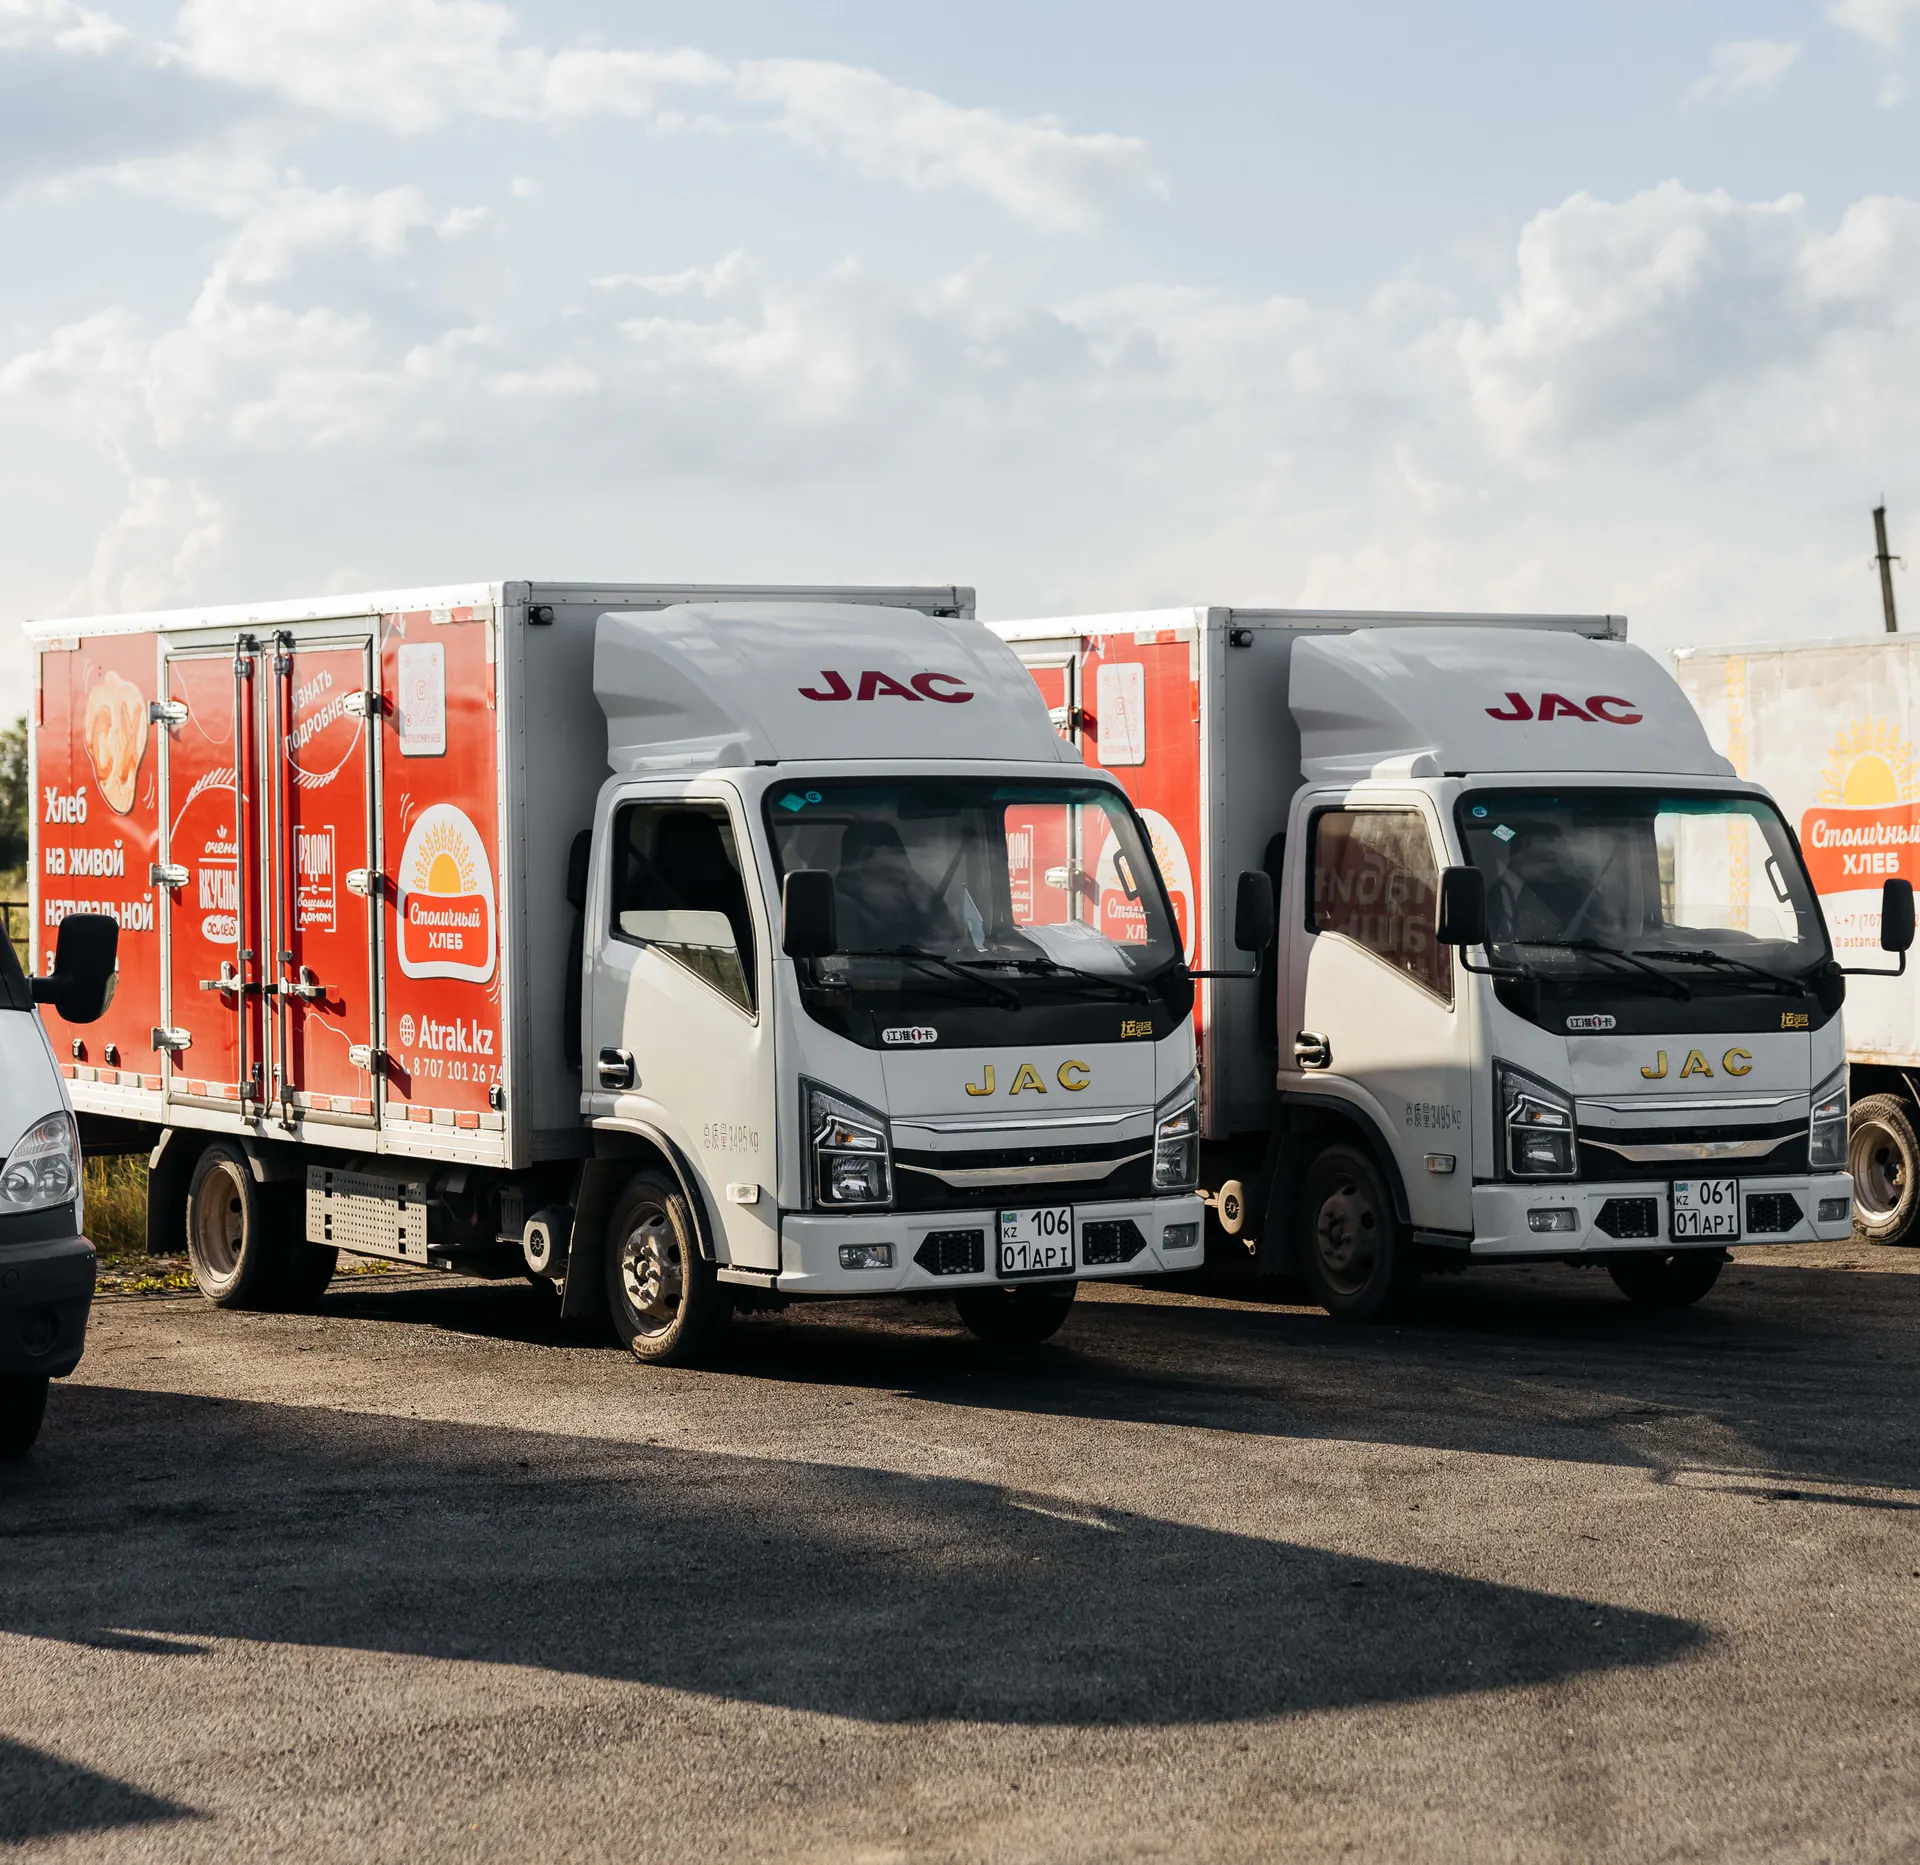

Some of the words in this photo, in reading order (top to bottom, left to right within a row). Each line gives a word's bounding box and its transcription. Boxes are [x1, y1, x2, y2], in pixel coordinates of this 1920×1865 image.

[291, 669, 332, 713] УЗНАТЬ
[798, 671, 974, 703] JAC
[1485, 692, 1643, 724] JAC
[44, 785, 87, 824] Хлеб
[45, 847, 66, 875] на
[69, 839, 124, 877] живой
[1843, 852, 1900, 875] ХЛЕБ
[410, 901, 481, 928] Столичный
[1859, 913, 1882, 931] (707
[428, 931, 463, 950] ХЛЕБ
[418, 1014, 494, 1055] Atrak.kz
[413, 1056, 421, 1077] 8
[423, 1057, 444, 1079] 707
[447, 1060, 469, 1081] 101
[472, 1062, 487, 1083] 26
[1640, 1048, 1753, 1079] JAC
[965, 1060, 1091, 1097] JAC
[1676, 1195, 1689, 1206] KZ
[1700, 1181, 1735, 1206] 061
[1003, 1226, 1018, 1239] KZ
[1030, 1209, 1069, 1237] 106
[1676, 1212, 1698, 1235] 01
[1003, 1245, 1027, 1270] 01
